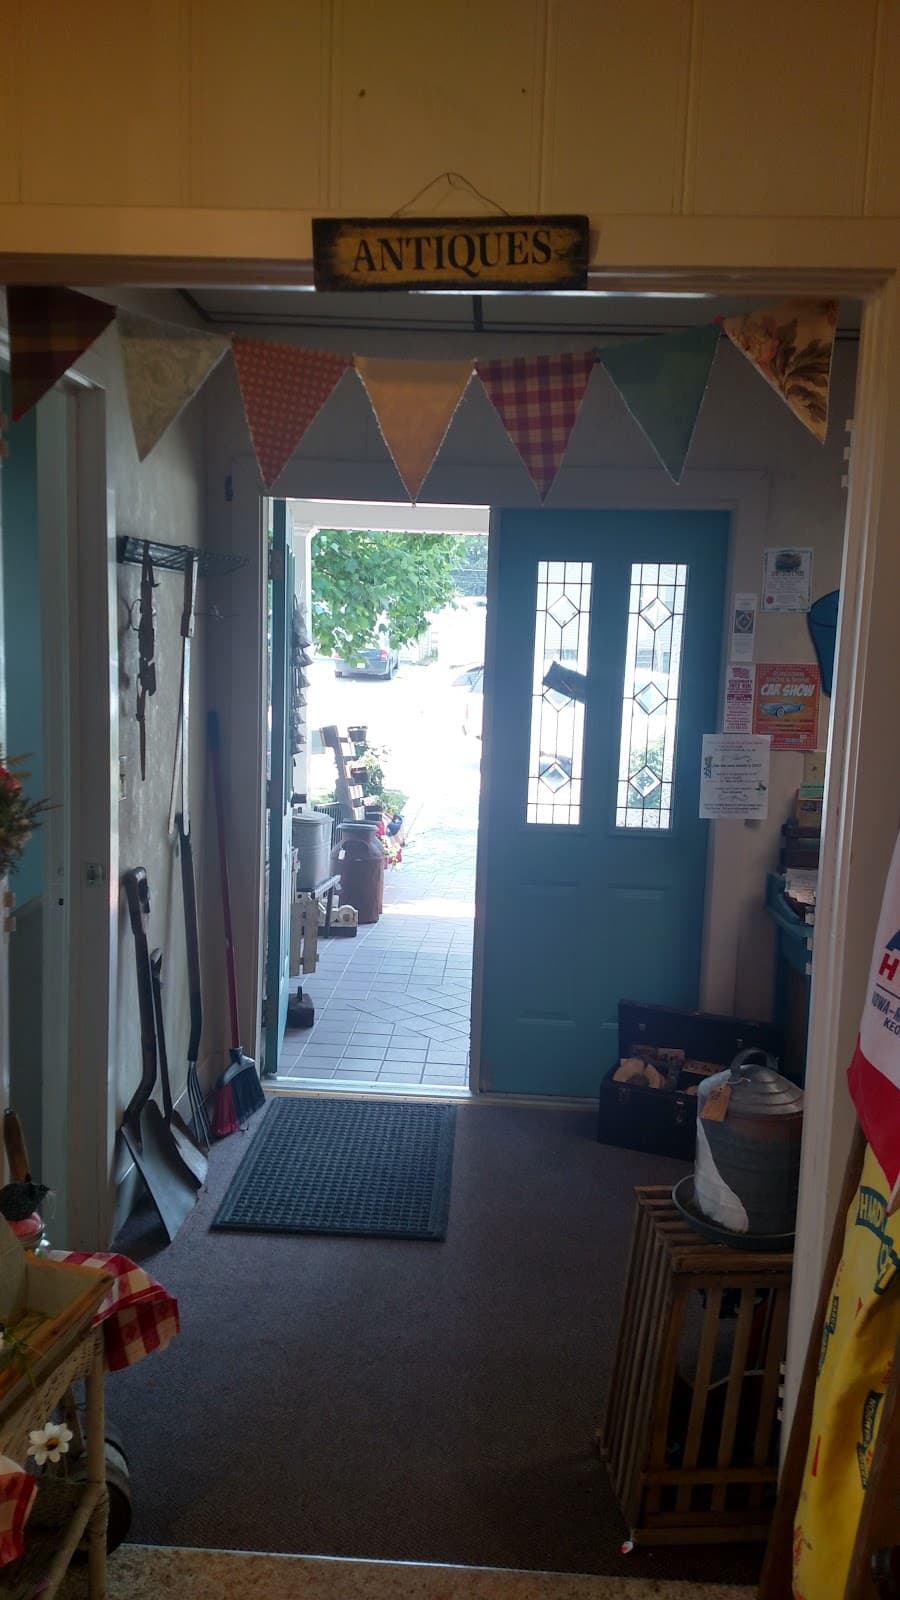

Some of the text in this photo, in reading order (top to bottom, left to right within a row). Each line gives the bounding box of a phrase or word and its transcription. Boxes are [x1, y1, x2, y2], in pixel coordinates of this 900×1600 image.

[352, 230, 551, 278] ANTIQUES
[761, 683, 781, 696] CAR
[782, 684, 816, 697] SHOW
[883, 1016, 900, 1037] KEO
